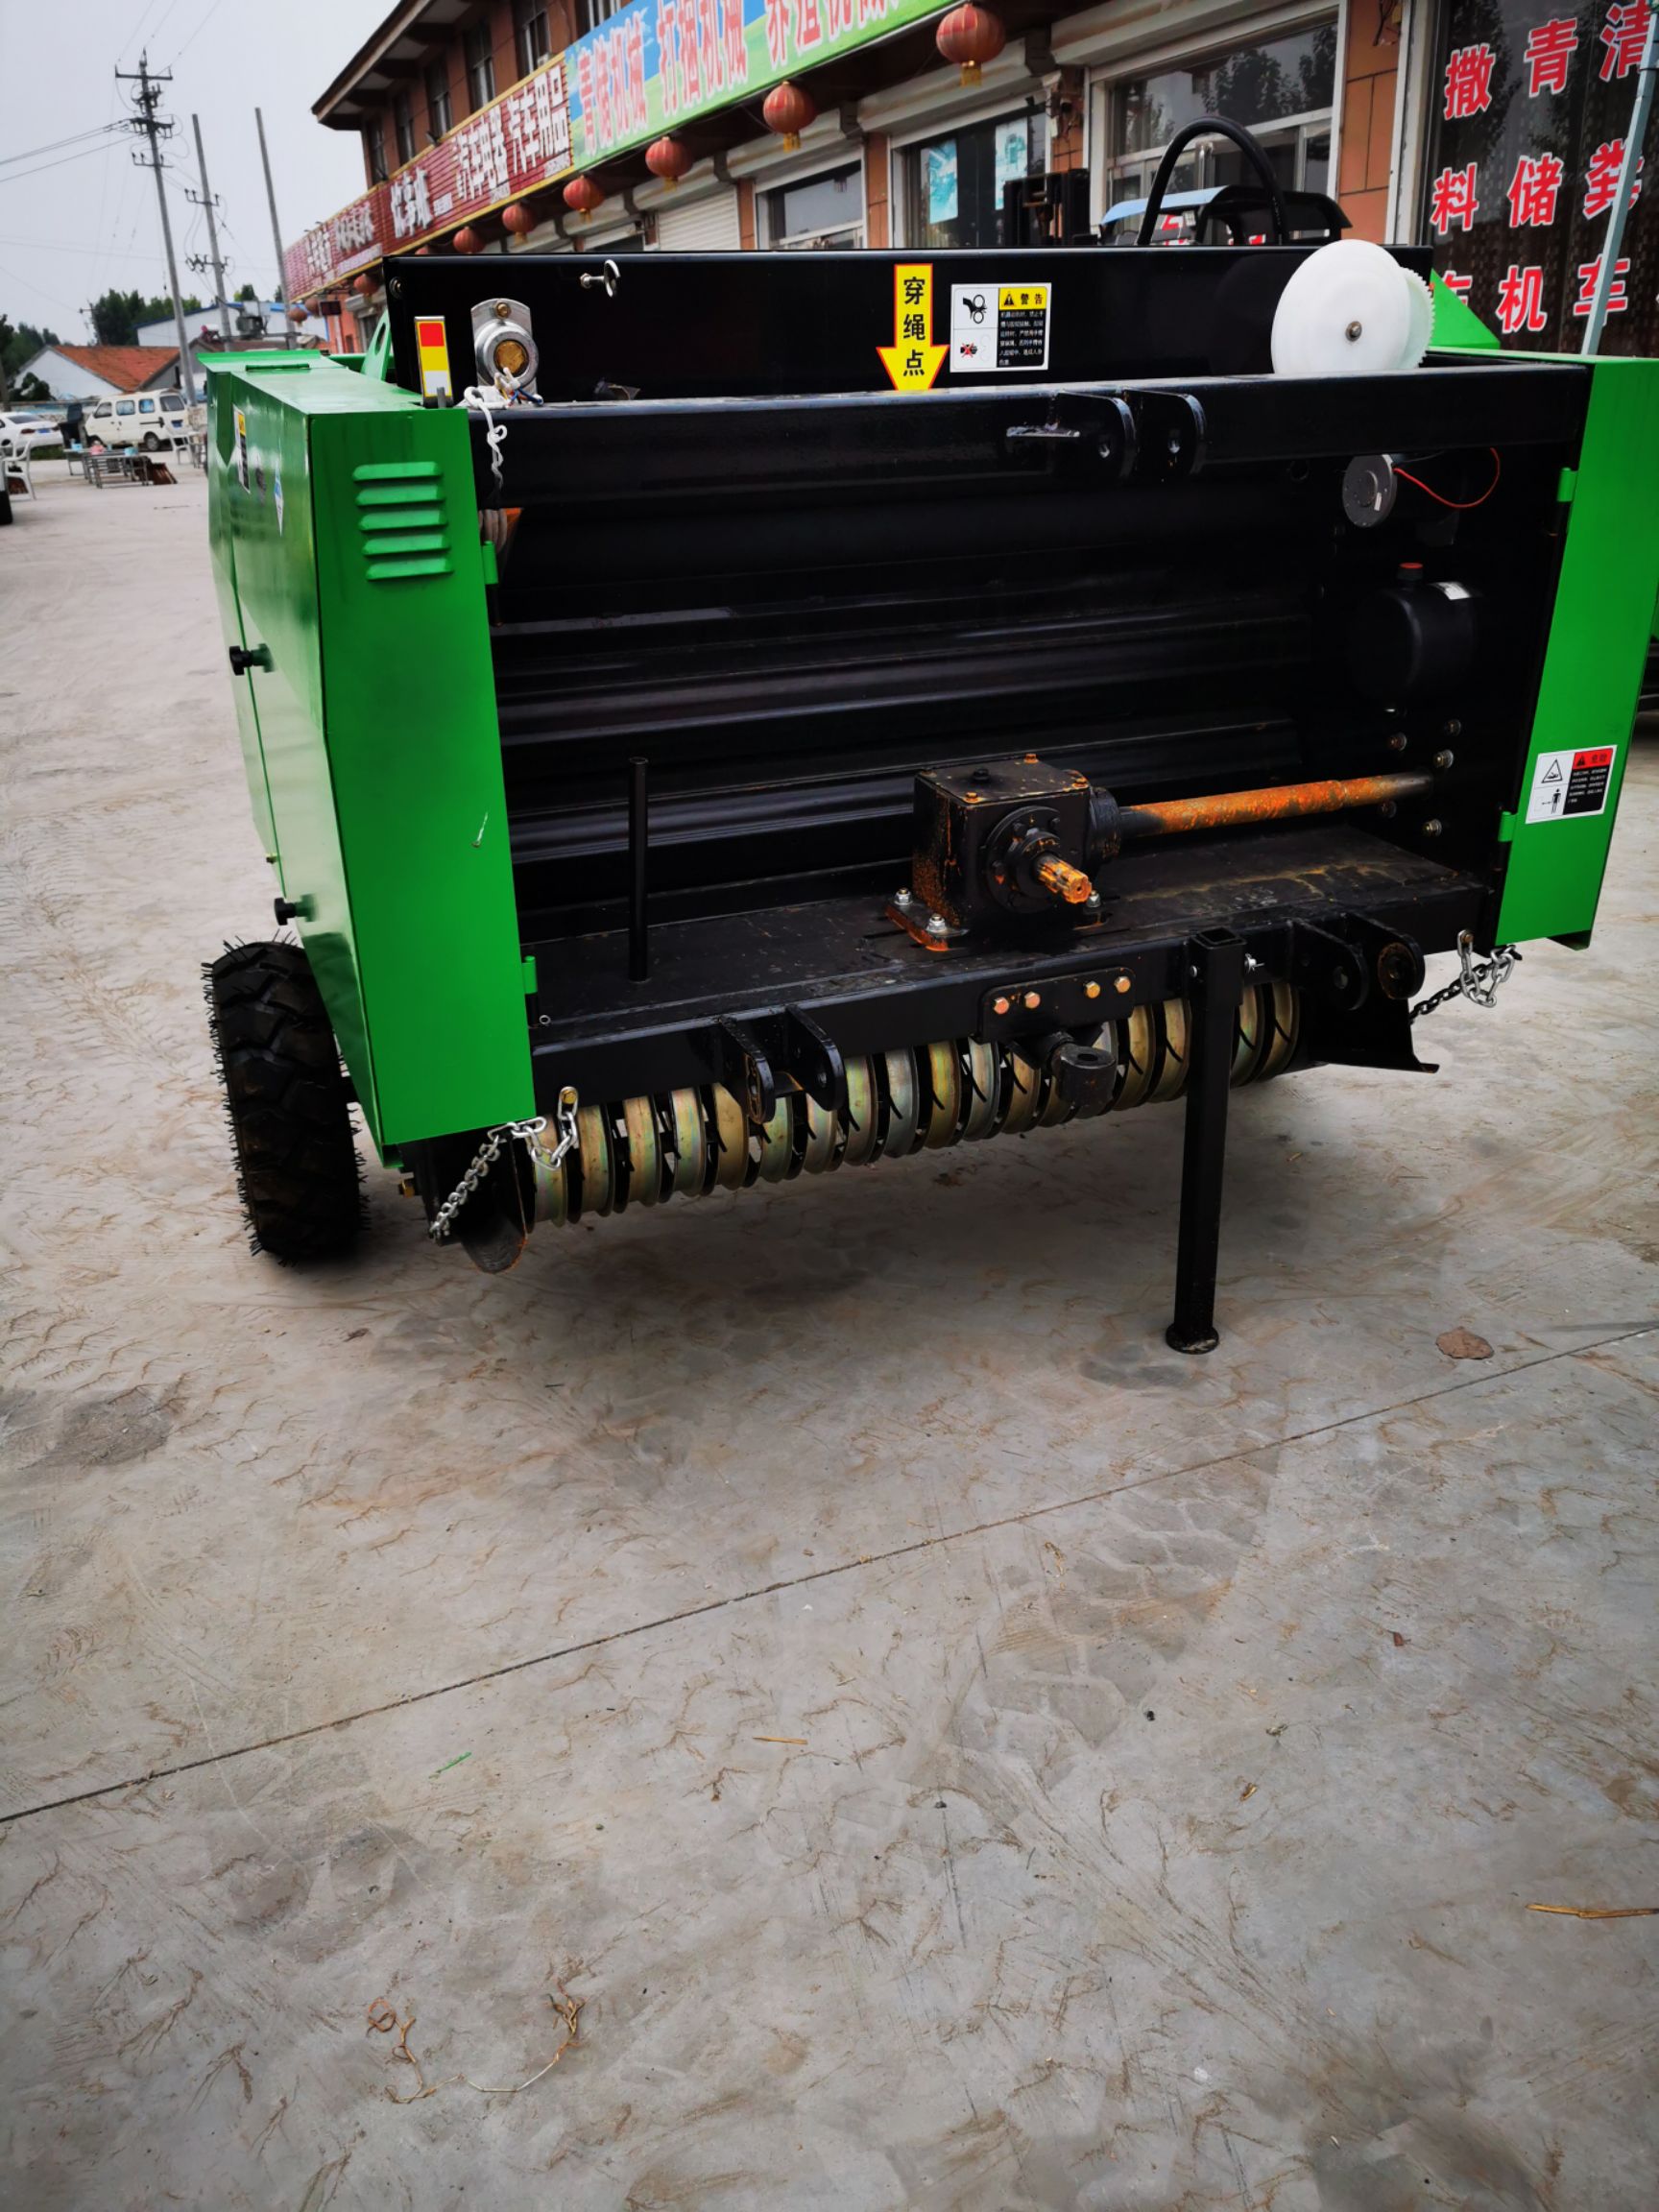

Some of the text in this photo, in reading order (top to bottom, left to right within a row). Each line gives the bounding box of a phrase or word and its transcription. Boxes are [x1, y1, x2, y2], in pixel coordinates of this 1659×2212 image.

[506, 63, 568, 175] 汽车用品
[1497, 17, 1578, 334] 青储机
[902, 276, 926, 377] 穿绳点
[1020, 293, 1044, 306] 警告
